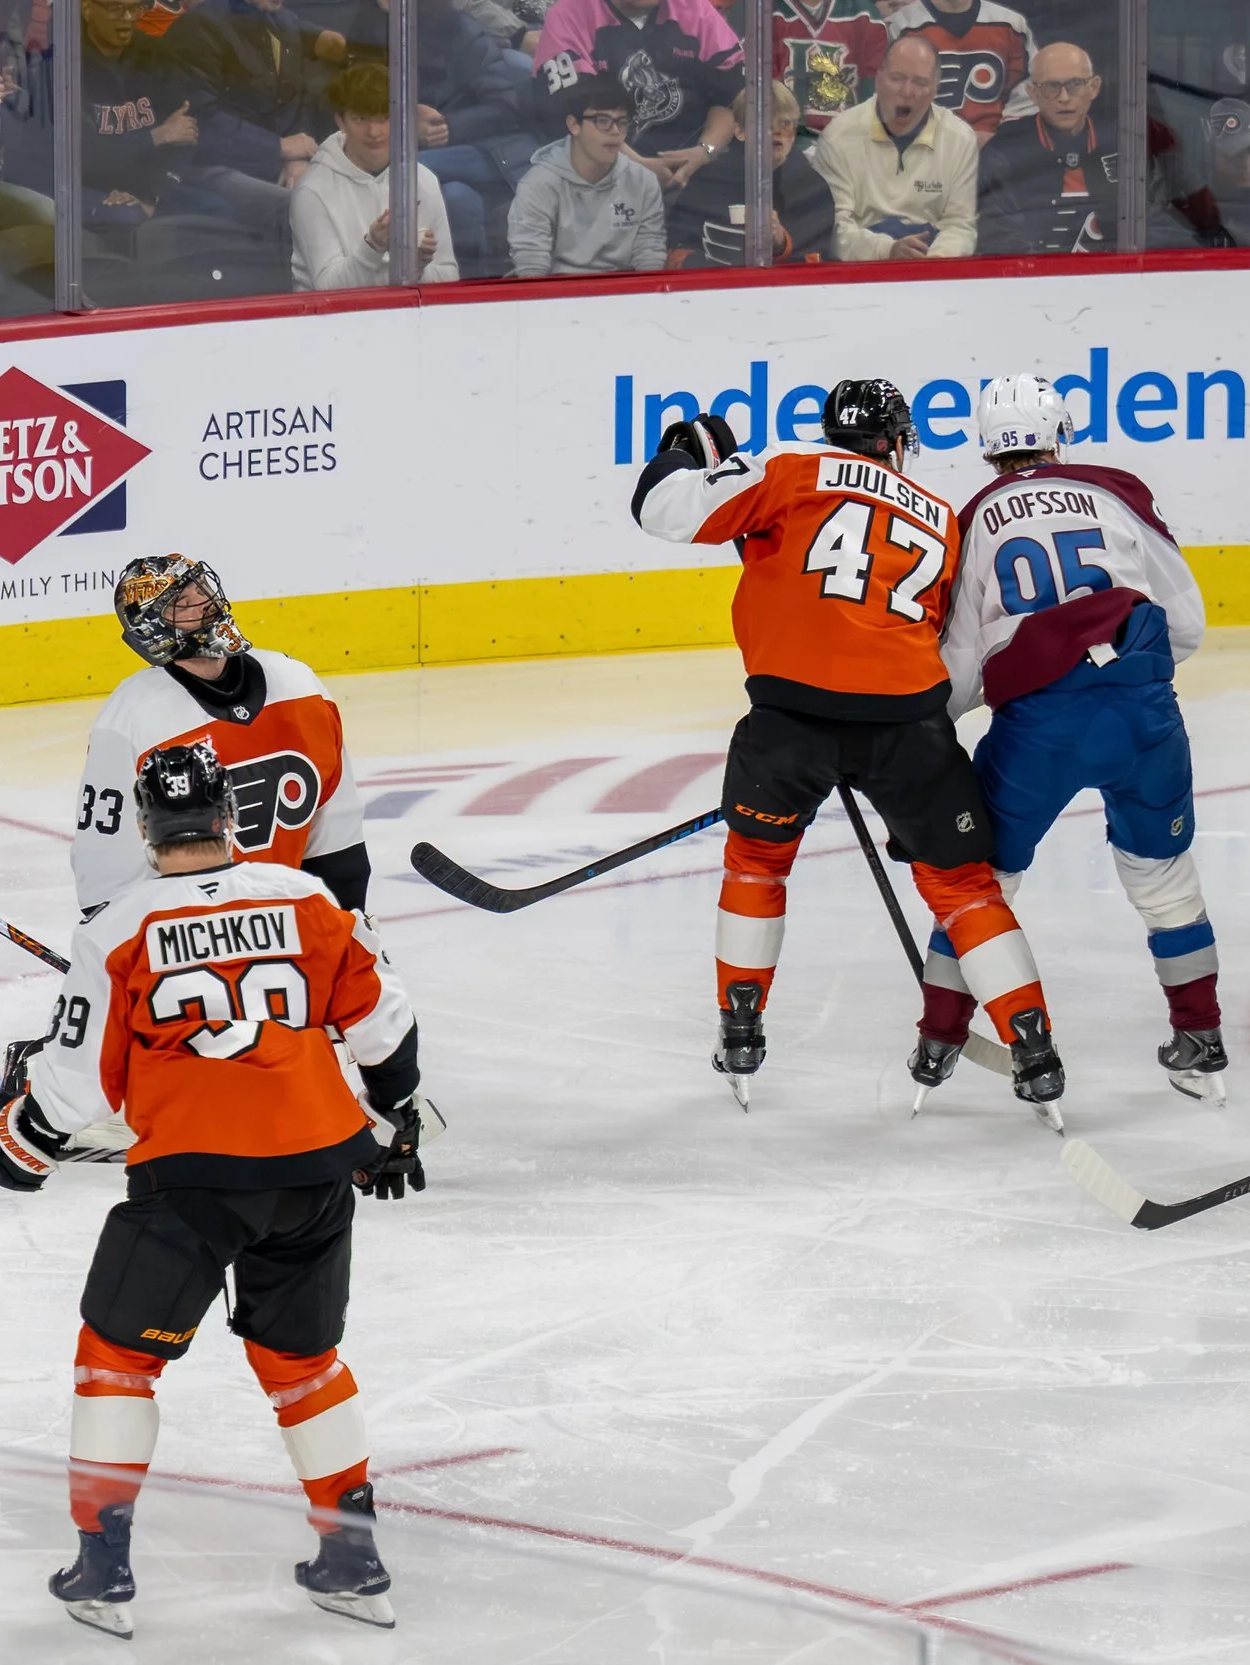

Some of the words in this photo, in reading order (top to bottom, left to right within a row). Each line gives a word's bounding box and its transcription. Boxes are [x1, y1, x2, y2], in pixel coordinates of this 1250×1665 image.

[543, 53, 578, 95] 39
[202, 404, 333, 443] ARTISAN
[839, 407, 859, 425] 47
[62, 420, 91, 454] &
[1002, 430, 1018, 447] 95
[199, 443, 337, 481] CHEESES
[825, 463, 940, 528] JUULSEN
[983, 491, 1099, 535] OLOFSSON
[803, 498, 948, 623] 47
[166, 774, 190, 797] 39
[77, 783, 124, 835] 33
[735, 803, 799, 826] CCM
[157, 912, 287, 966] MICHKOV
[146, 958, 310, 1060] 39
